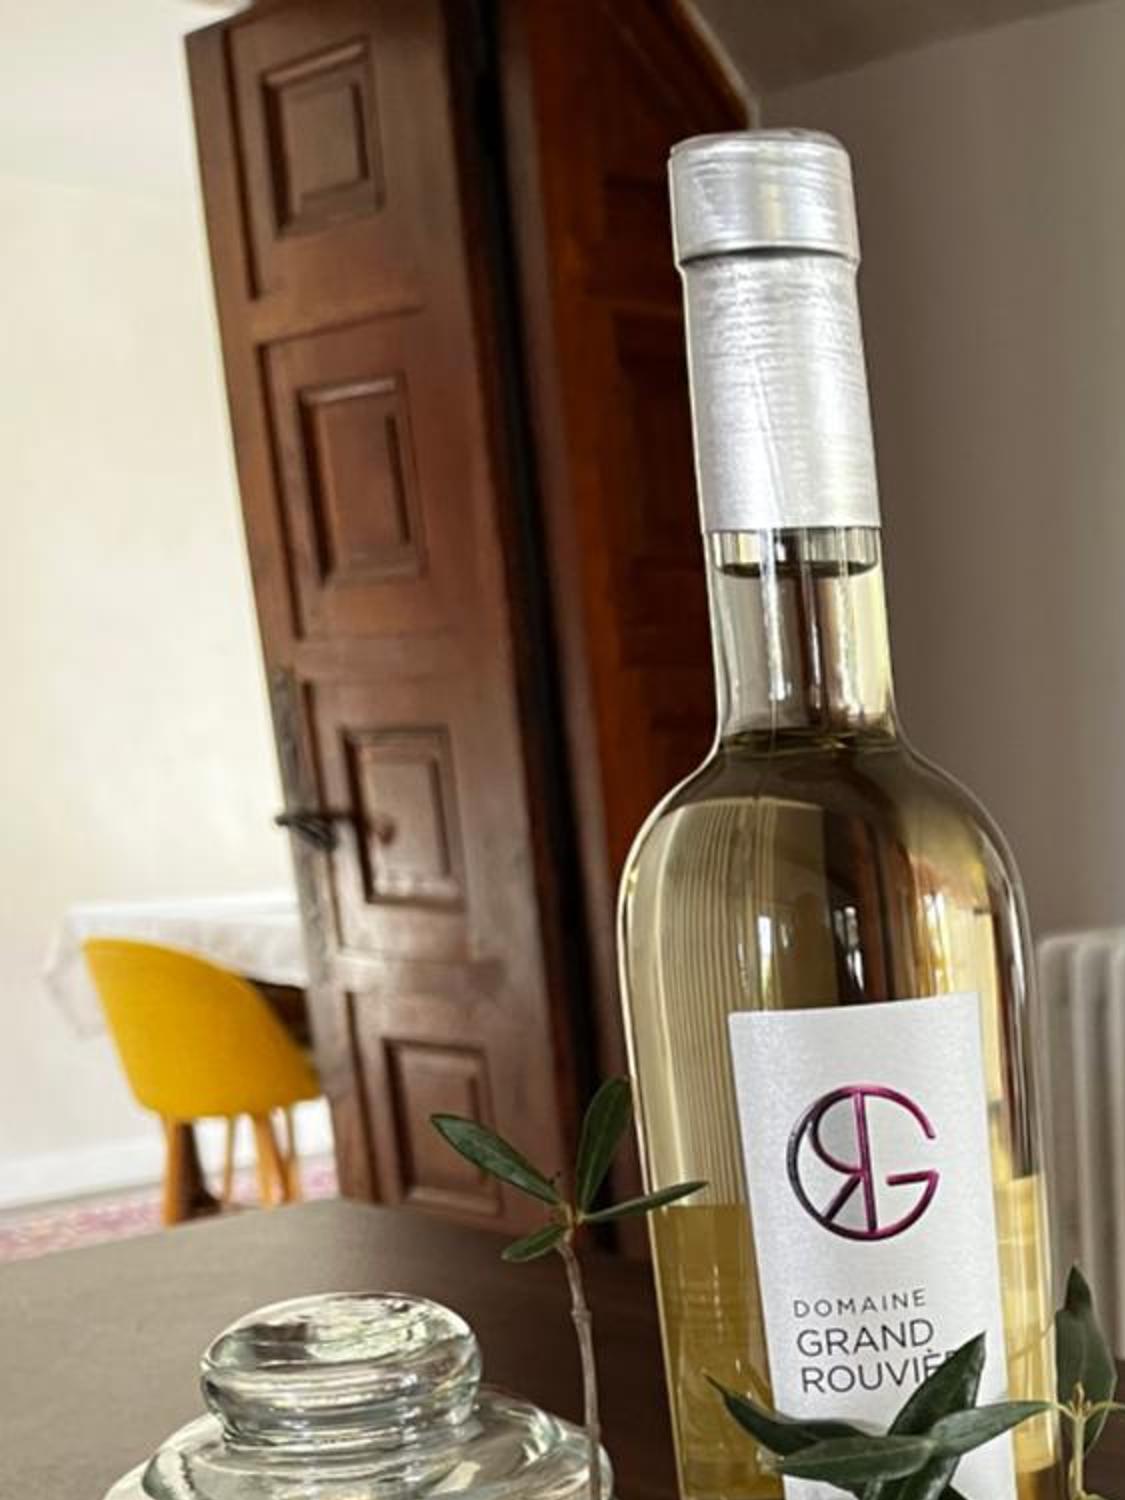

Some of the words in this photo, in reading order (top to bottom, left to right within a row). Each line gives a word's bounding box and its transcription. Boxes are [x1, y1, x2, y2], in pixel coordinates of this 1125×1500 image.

[793, 1288, 928, 1319] DOMAINE
[797, 1317, 935, 1357] GRAND
[801, 1348, 952, 1394] ROUVIÈ
